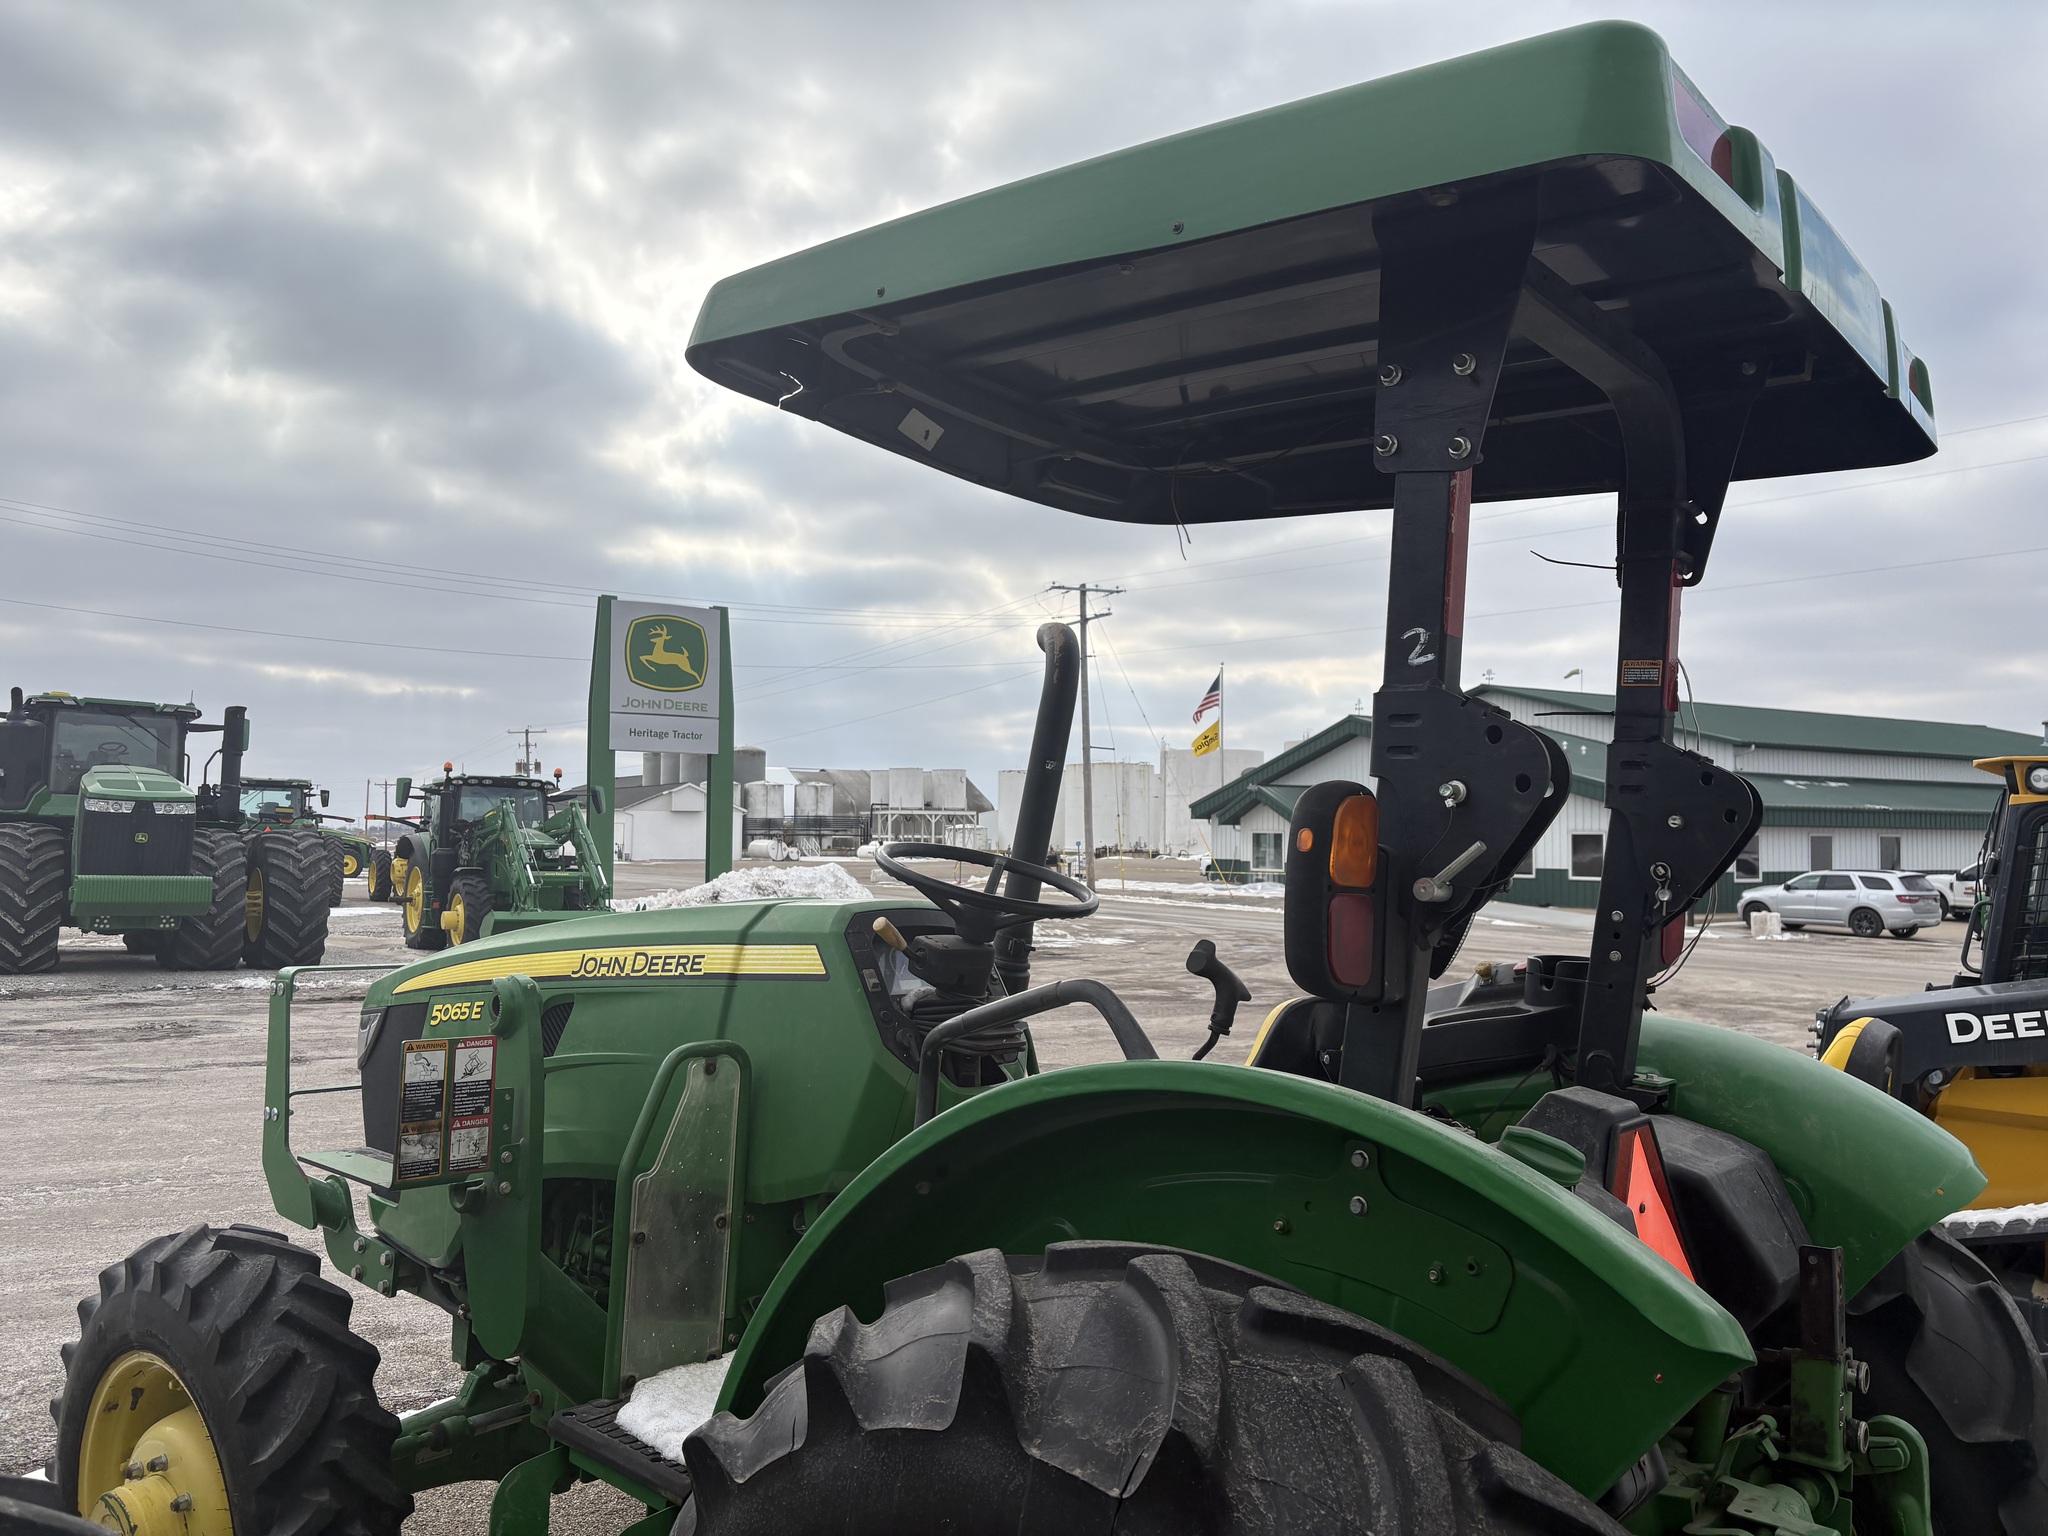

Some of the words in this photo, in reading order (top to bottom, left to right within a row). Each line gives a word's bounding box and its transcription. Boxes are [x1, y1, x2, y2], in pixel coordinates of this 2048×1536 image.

[1400, 627, 1436, 667] 2
[621, 696, 662, 710] JOHN
[663, 698, 708, 713] DEERE
[629, 727, 669, 740] Heritage
[672, 729, 703, 740] Tractor
[570, 952, 628, 977] JOHN
[630, 951, 707, 976] DEERE
[1945, 1009, 2048, 1044] DEE
[415, 1042, 447, 1050] WARNING
[466, 1039, 493, 1047] DANGER
[461, 1118, 489, 1127] DANGER
